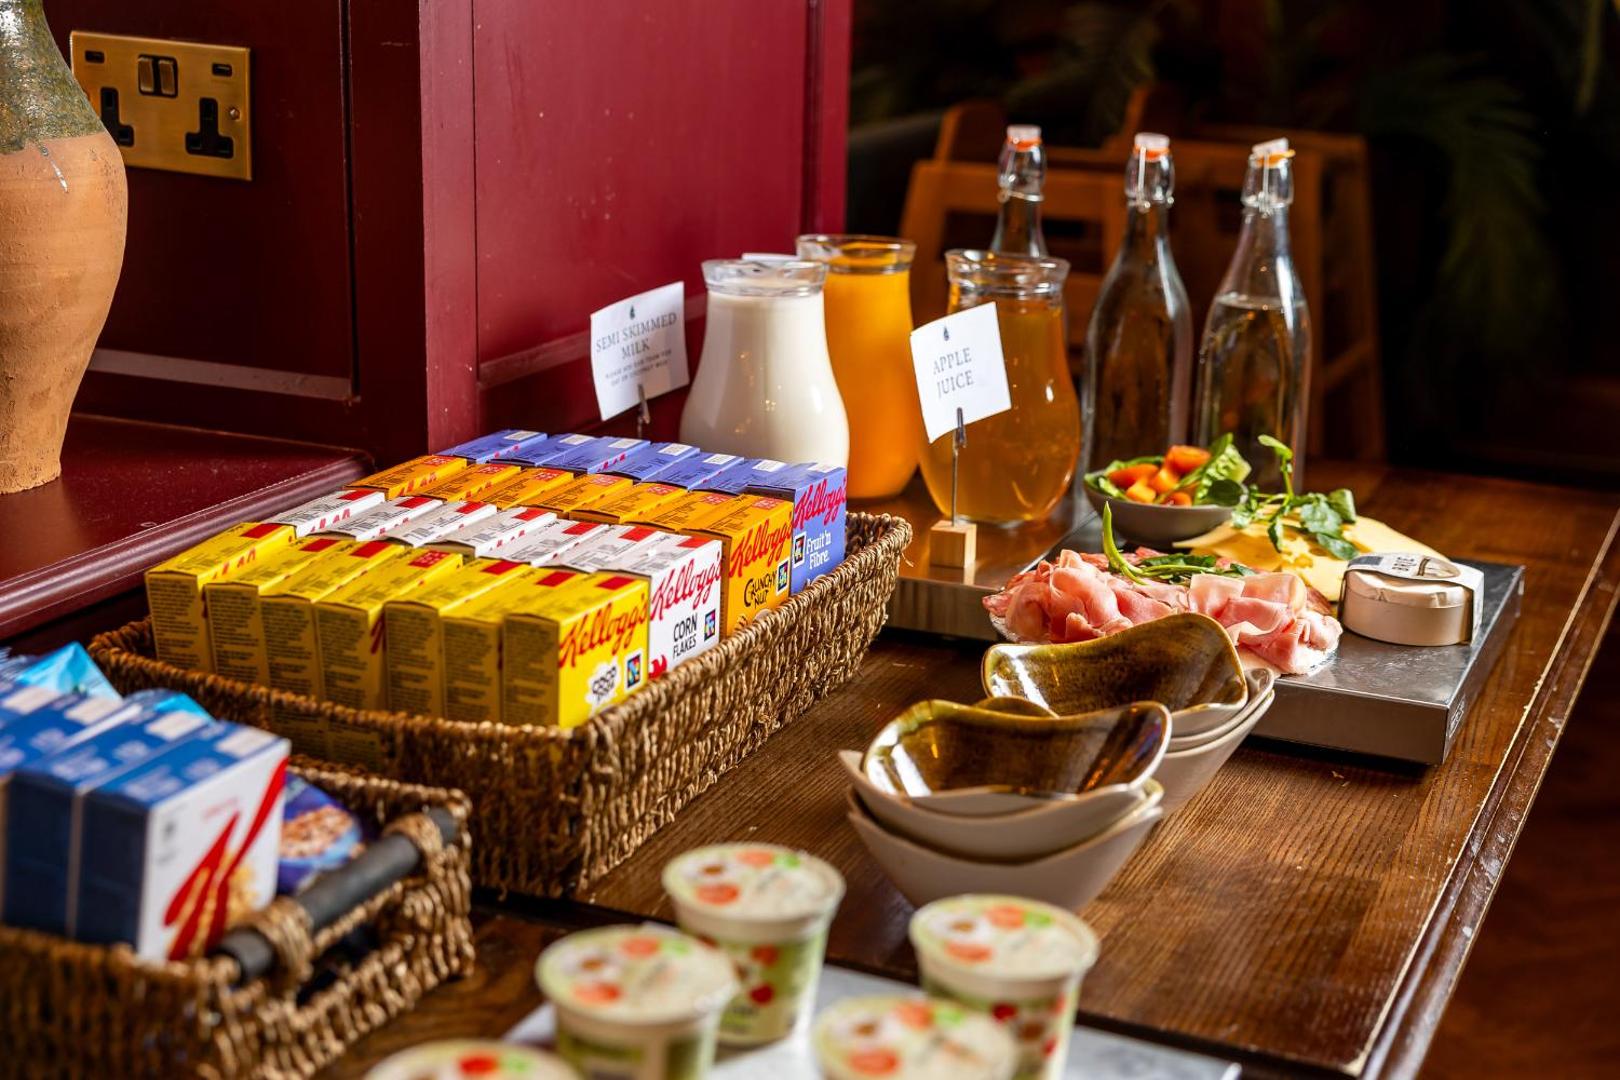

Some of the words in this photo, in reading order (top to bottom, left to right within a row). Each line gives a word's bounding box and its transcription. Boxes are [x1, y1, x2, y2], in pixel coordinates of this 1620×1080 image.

[596, 331, 620, 353] SEMI
[622, 312, 678, 341] SKIMMED
[622, 338, 650, 360] MILK
[933, 347, 972, 376] APPLE
[937, 369, 975, 399] JUICE
[792, 477, 847, 530] Kellogg's
[728, 512, 793, 578] Kellogg's
[650, 551, 722, 622] Kellogg's
[559, 592, 648, 669] Kellogg's
[673, 613, 698, 642] CORN
[672, 633, 697, 659] FLAKES
